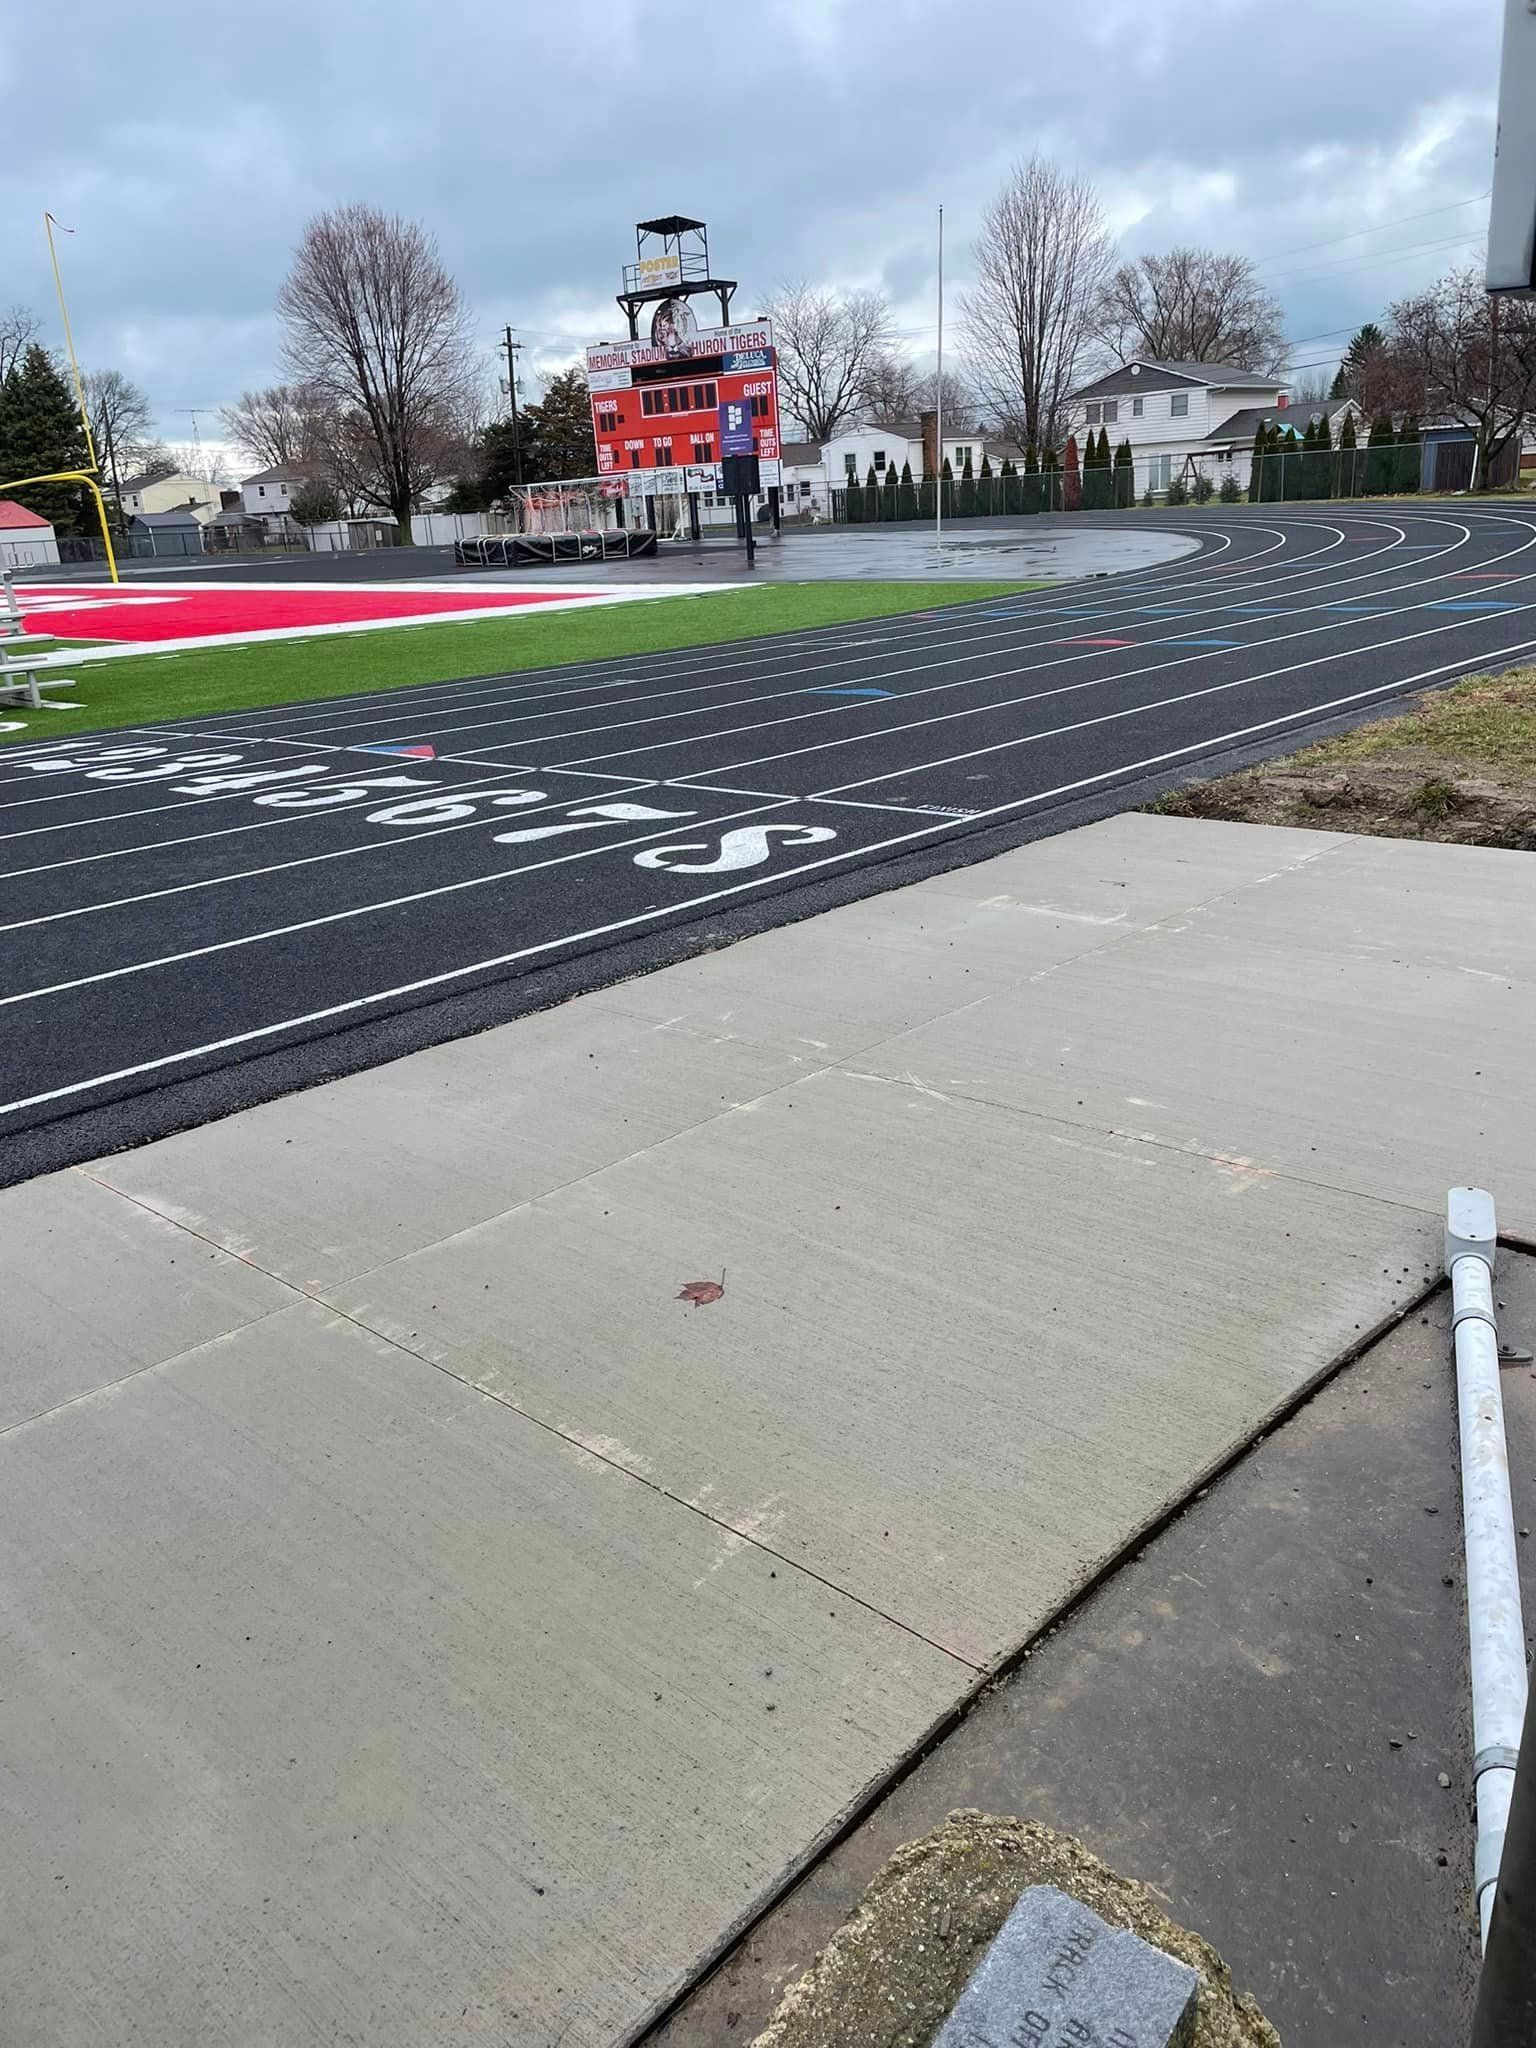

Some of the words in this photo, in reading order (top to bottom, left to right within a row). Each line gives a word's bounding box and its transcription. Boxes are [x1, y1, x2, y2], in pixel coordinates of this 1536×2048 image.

[691, 336, 727, 356] HURON
[730, 331, 767, 350] TIGERS
[589, 350, 630, 369] MEMORIAL
[631, 345, 667, 364] STADIUM
[743, 381, 772, 396] GUEST
[594, 400, 617, 413] TIGERS
[653, 437, 662, 448] TO
[662, 436, 672, 447] GO
[690, 433, 704, 444] BALL
[705, 432, 714, 443] ON
[760, 428, 774, 438] TIME
[760, 438, 776, 447] OUTS
[624, 439, 644, 450] DOWN
[761, 447, 774, 457] LEFT
[13, 747, 168, 770] 2
[85, 753, 244, 780] 3
[168, 765, 330, 795] 4
[253, 776, 443, 807] 5
[365, 789, 548, 825] 6
[493, 803, 698, 843] 7
